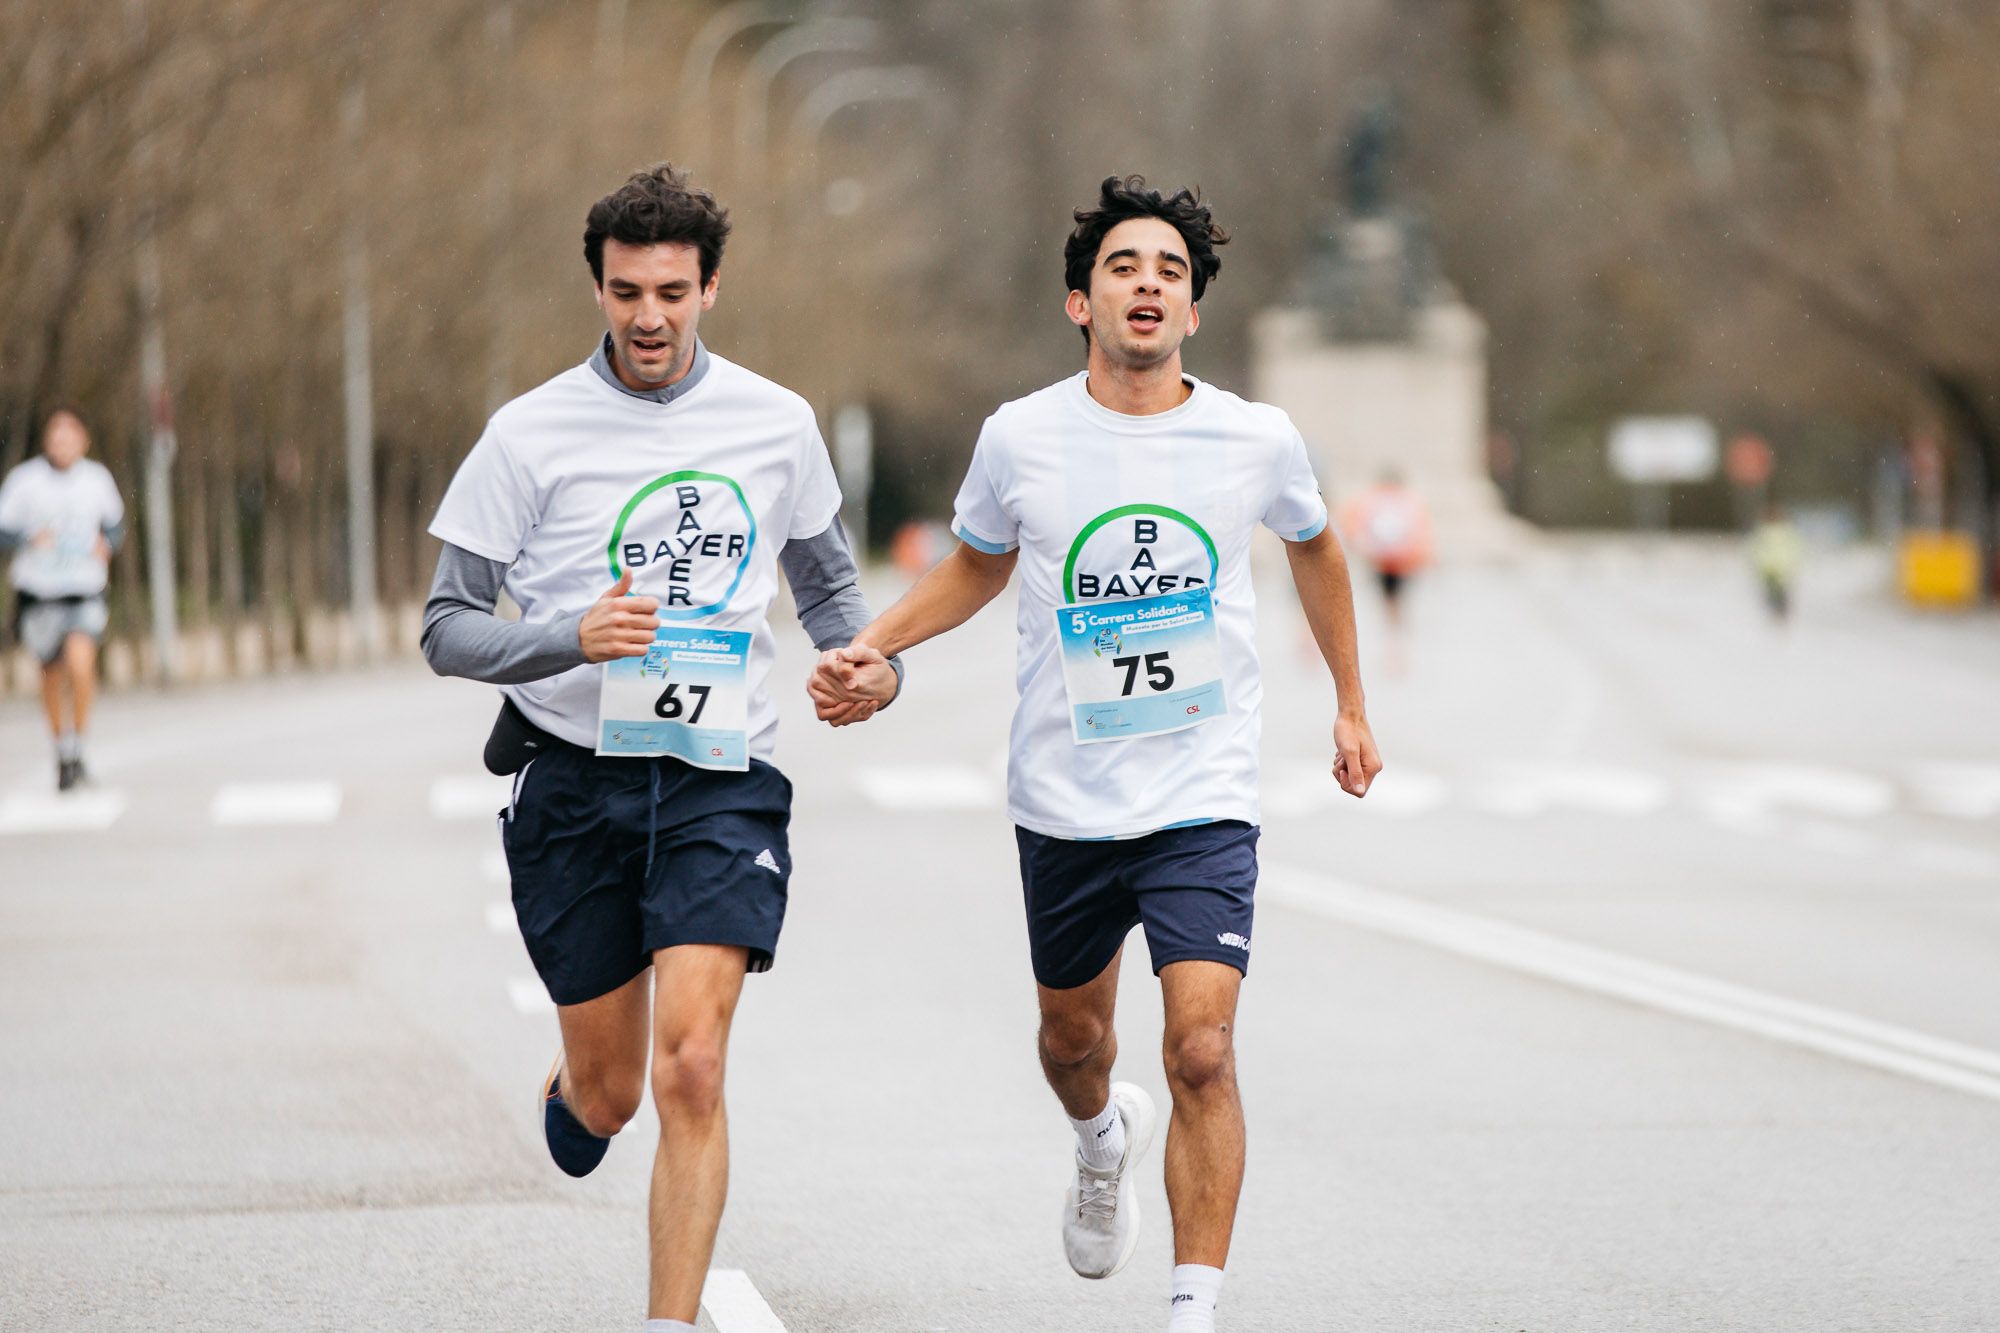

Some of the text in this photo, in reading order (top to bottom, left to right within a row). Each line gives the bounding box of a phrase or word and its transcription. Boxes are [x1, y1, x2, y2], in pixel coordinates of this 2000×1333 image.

[623, 534, 745, 568] BAYER
[668, 486, 702, 606] BAYER
[1089, 613, 1135, 626] Carrera
[1136, 603, 1189, 620] Solidaria
[1112, 651, 1175, 696] 75
[654, 683, 712, 724] 67
